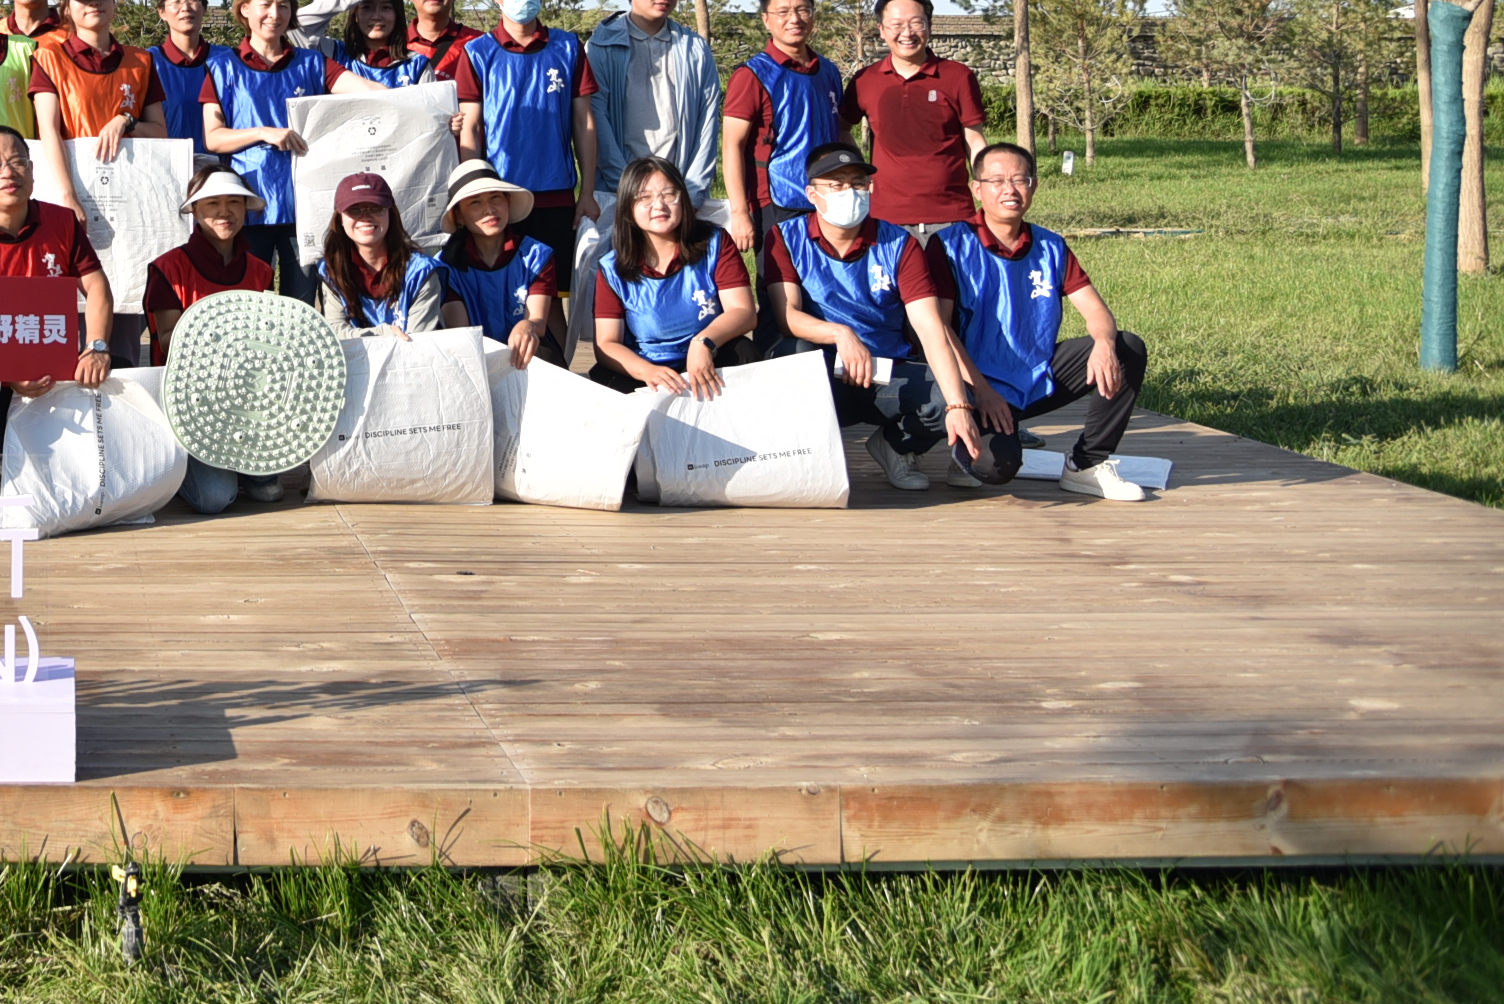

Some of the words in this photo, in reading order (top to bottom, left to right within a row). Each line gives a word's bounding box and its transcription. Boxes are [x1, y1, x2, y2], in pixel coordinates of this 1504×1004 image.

[96, 412, 102, 424] ME
[364, 428, 407, 438] DISCIPLINE
[408, 426, 427, 434] SETS
[442, 422, 461, 430] FREE
[714, 455, 757, 466] DISCIPLINE
[758, 452, 777, 460] SETS
[792, 448, 812, 456] FREE
[98, 445, 106, 487] DISCIPLINE
